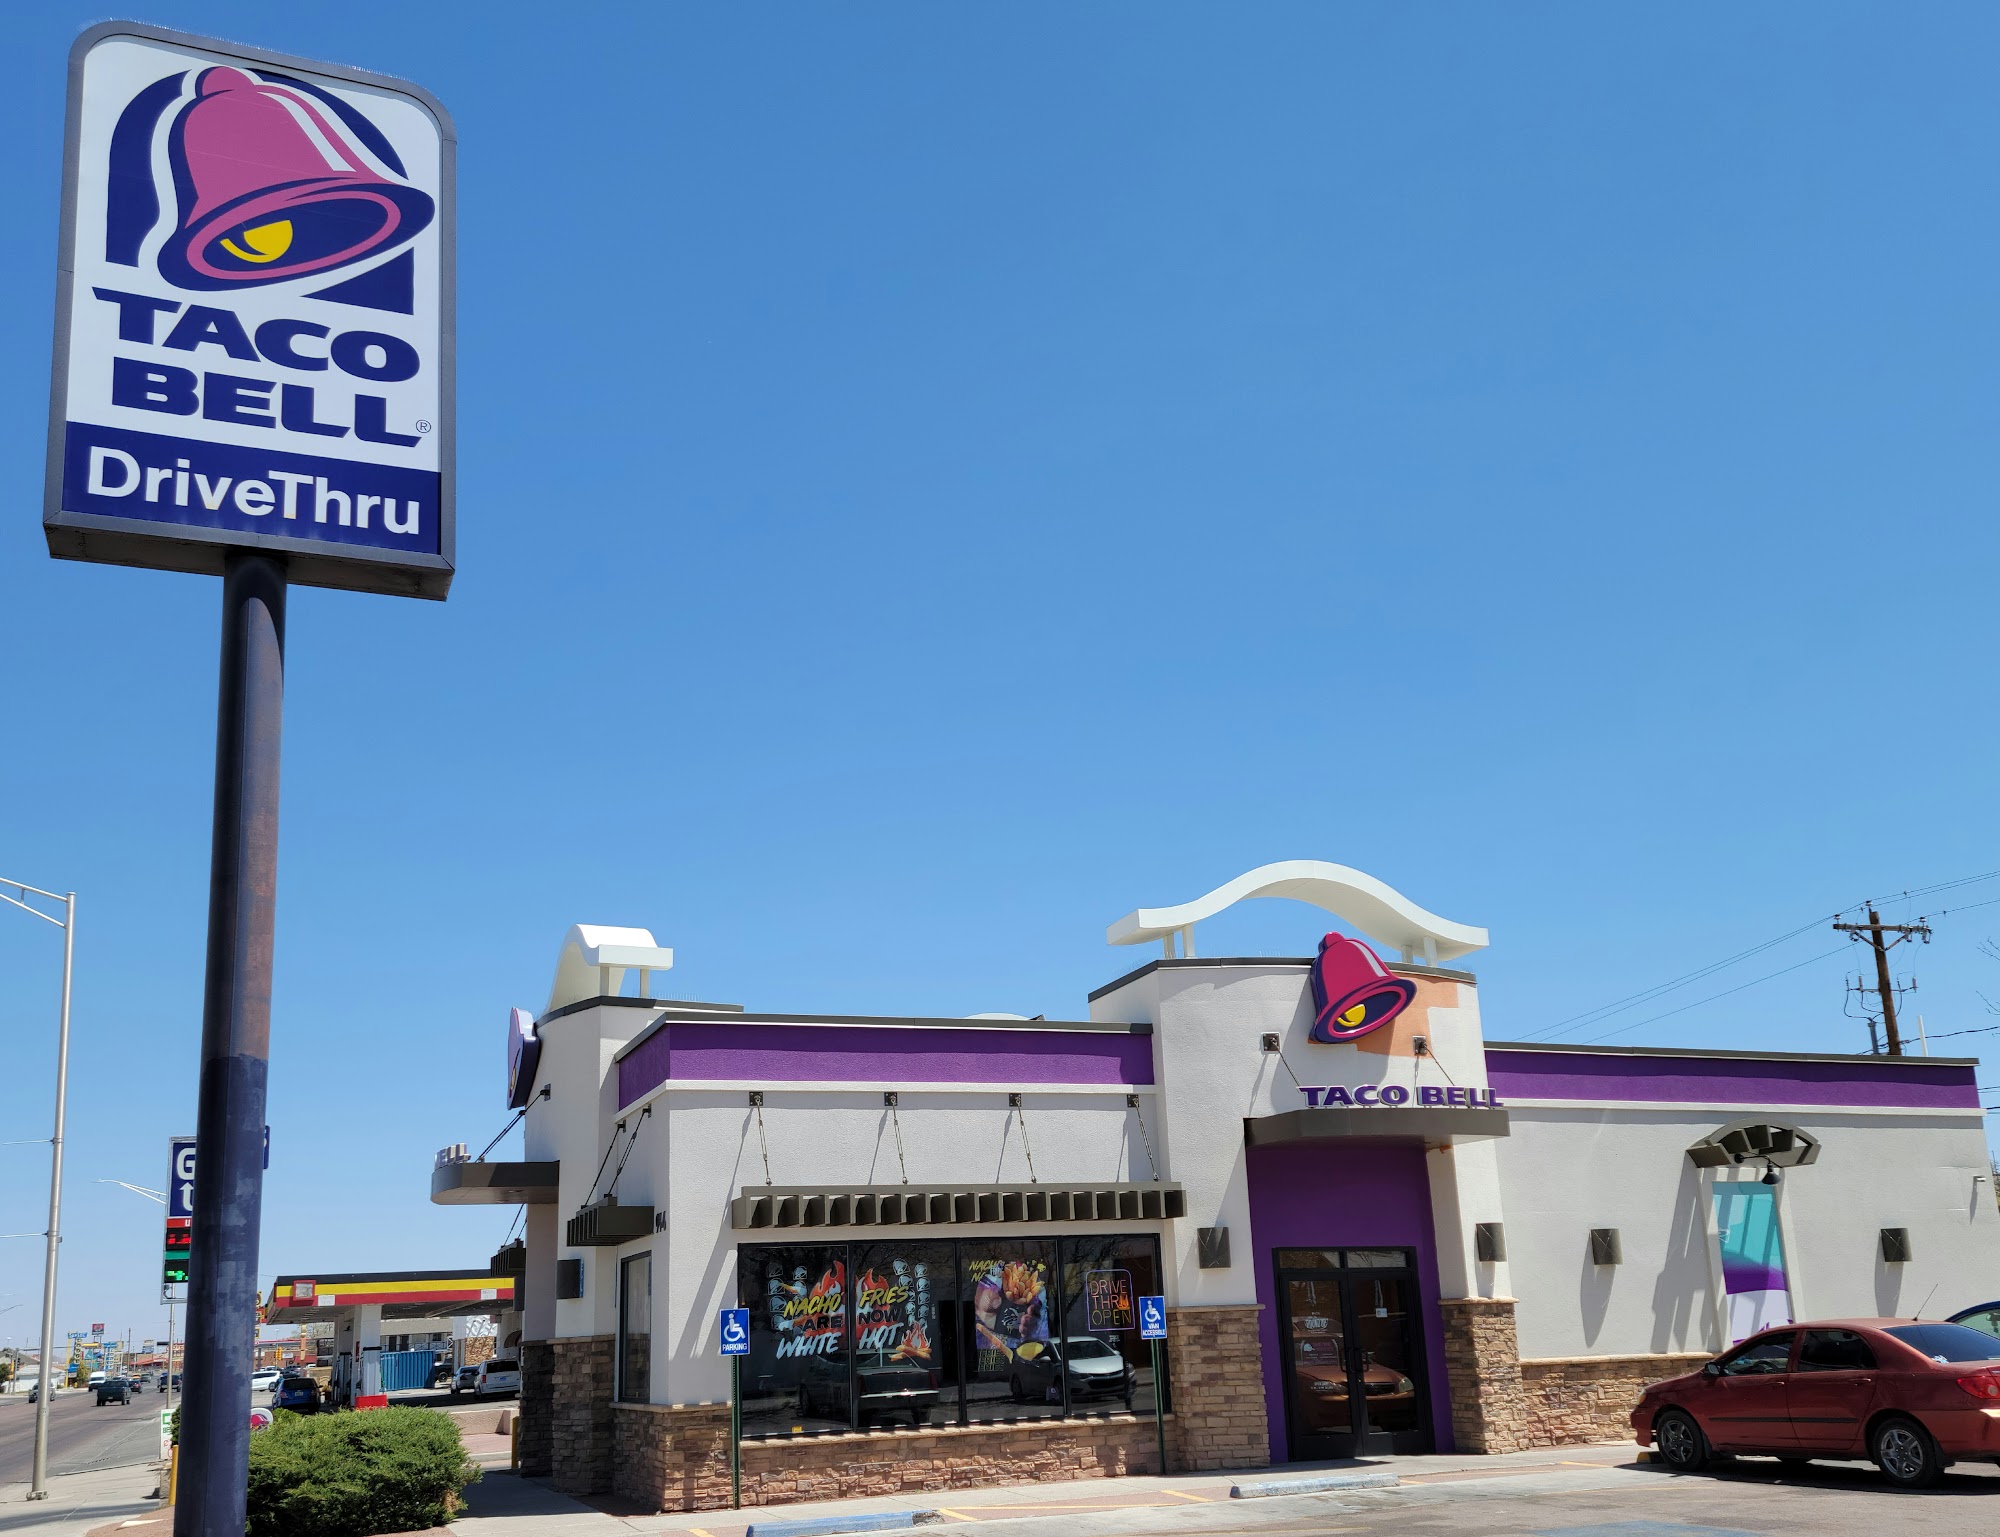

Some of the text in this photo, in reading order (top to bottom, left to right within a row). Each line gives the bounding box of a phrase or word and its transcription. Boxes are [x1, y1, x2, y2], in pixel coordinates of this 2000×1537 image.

[91, 286, 421, 383] TACO
[111, 356, 422, 447] BELL
[87, 445, 420, 536] DriveThru
[1299, 1084, 1505, 1109] TACO BELL
[1089, 1279, 1128, 1296] DRIVE
[783, 1285, 909, 1318] NACHO FRIES
[1091, 1294, 1130, 1310] THRU
[802, 1308, 901, 1332] ARE NOW
[1091, 1309, 1132, 1326] OPEN
[722, 1342, 748, 1352] PARKING
[775, 1321, 905, 1360] WHITE HOT
